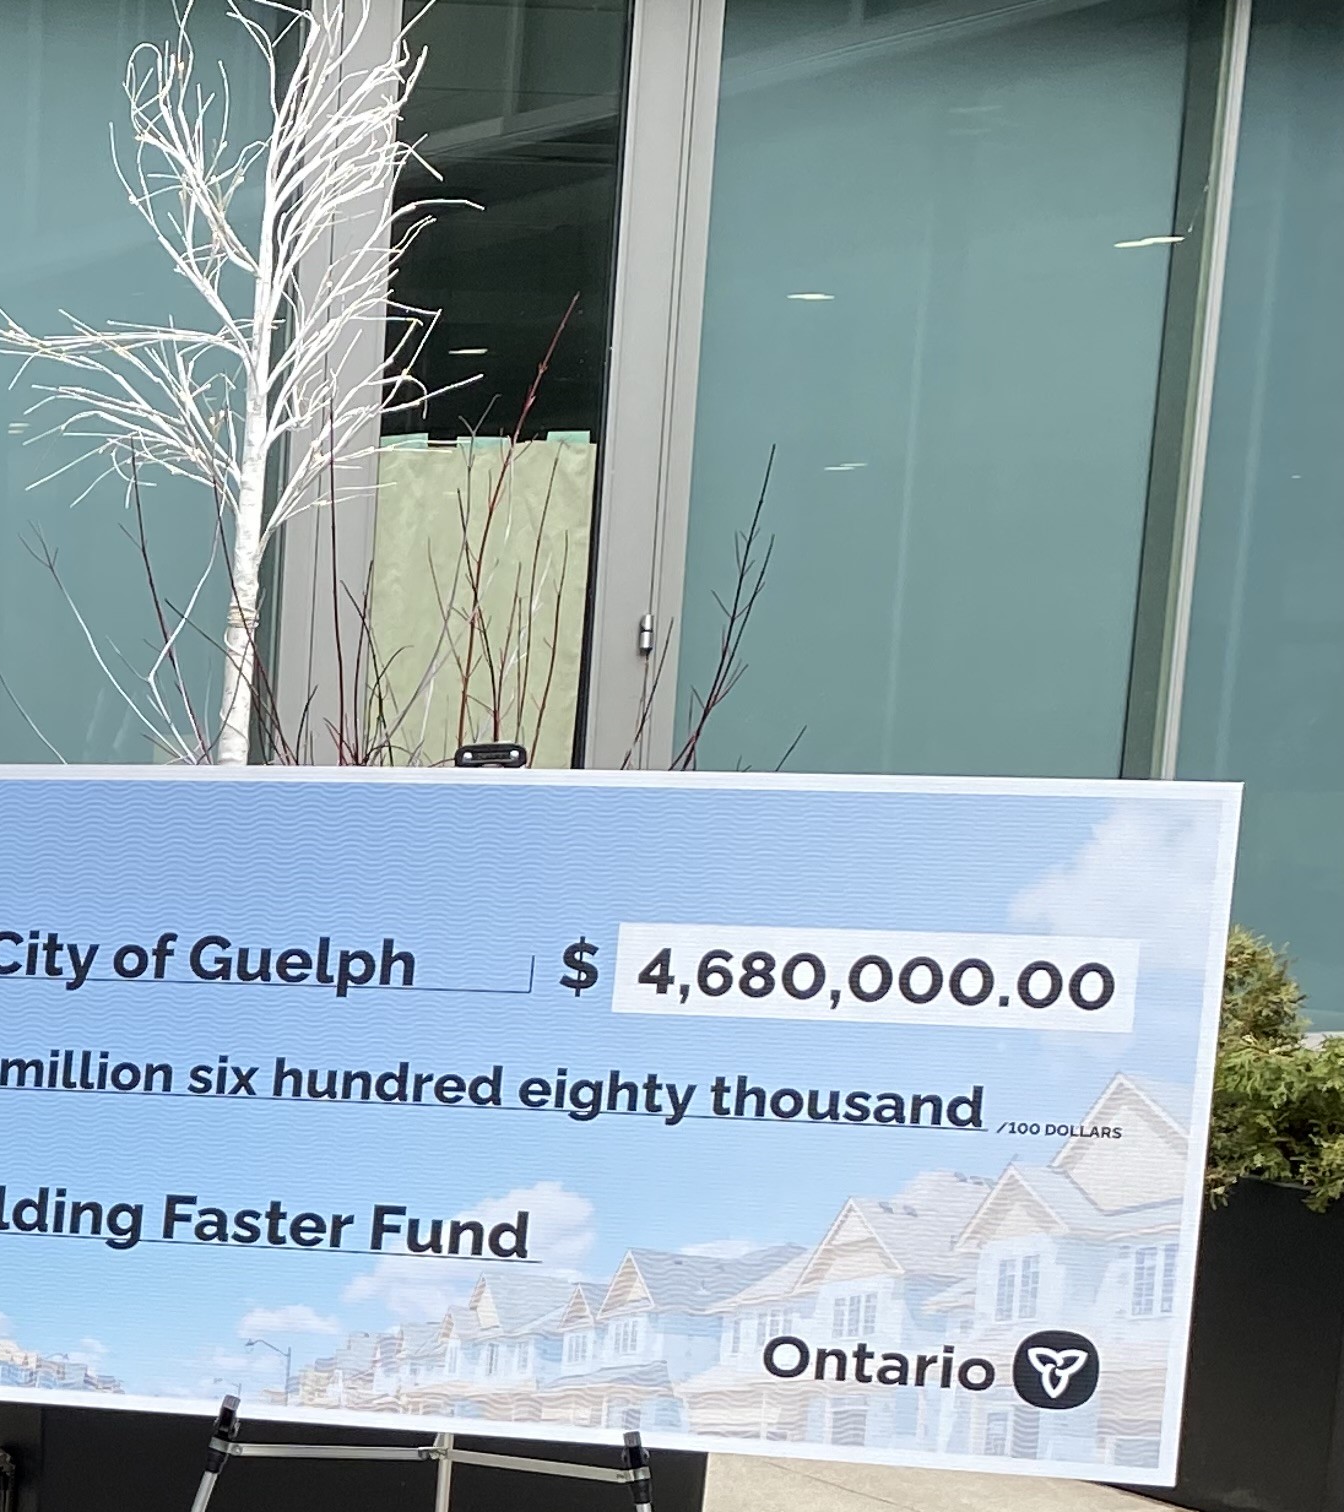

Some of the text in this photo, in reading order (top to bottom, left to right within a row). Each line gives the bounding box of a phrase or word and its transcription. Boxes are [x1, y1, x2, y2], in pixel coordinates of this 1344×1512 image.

[113, 932, 178, 979] of
[190, 935, 415, 997] Guelph
[559, 936, 1116, 1011] $ 4,680,000.00
[187, 1055, 259, 1097] six
[272, 1057, 503, 1107] hundred
[518, 1067, 697, 1126] eighty
[710, 1075, 985, 1128] thousand
[996, 1121, 1123, 1139] /100 DOLLARS
[162, 1194, 355, 1249] Faster
[369, 1203, 530, 1260] Fund
[762, 1334, 997, 1393] Ontario
